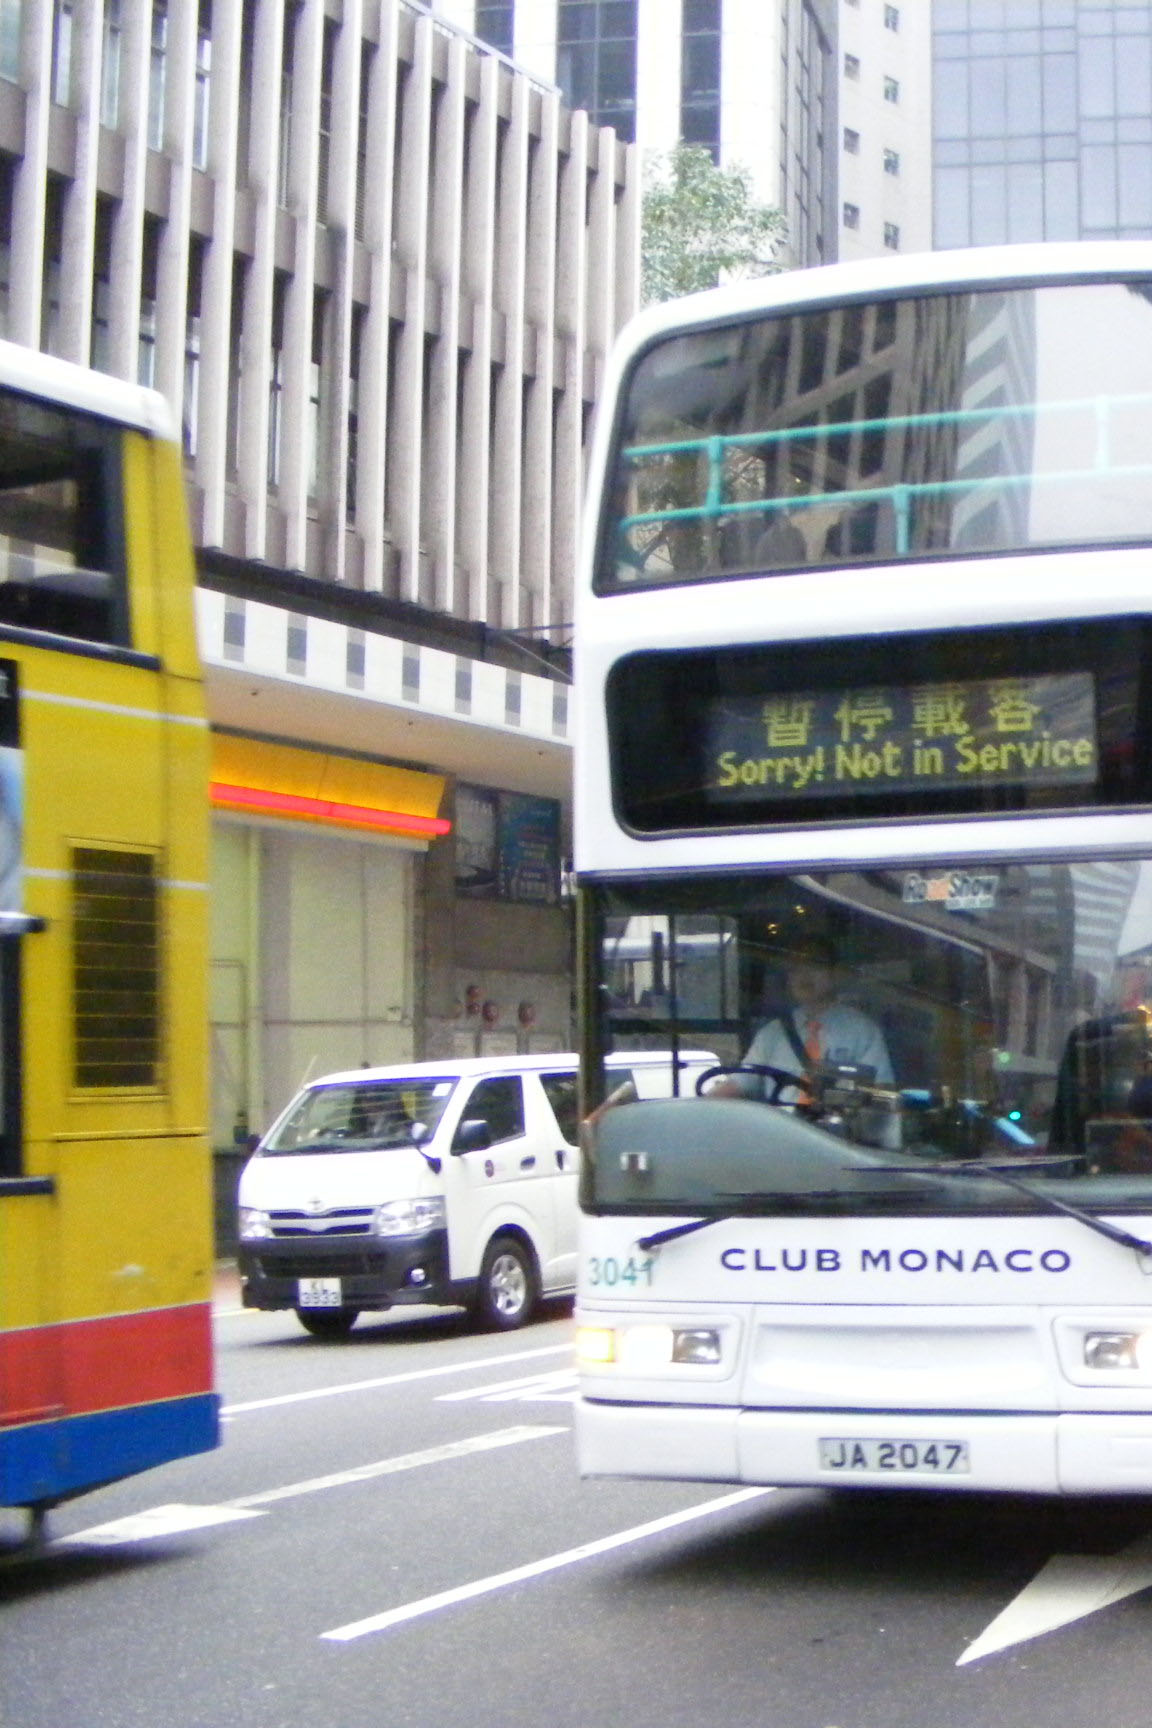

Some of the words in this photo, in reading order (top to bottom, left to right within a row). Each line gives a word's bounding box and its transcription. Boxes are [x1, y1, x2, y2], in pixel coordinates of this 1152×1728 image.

[719, 746, 825, 789] Sorry!
[835, 741, 901, 780] Not
[912, 739, 944, 775] in
[955, 731, 1093, 773] Service
[719, 1247, 842, 1273] CLUB
[860, 1248, 1072, 1273] MONACO
[829, 1442, 868, 1469] JA
[878, 1442, 962, 1470] 2047
